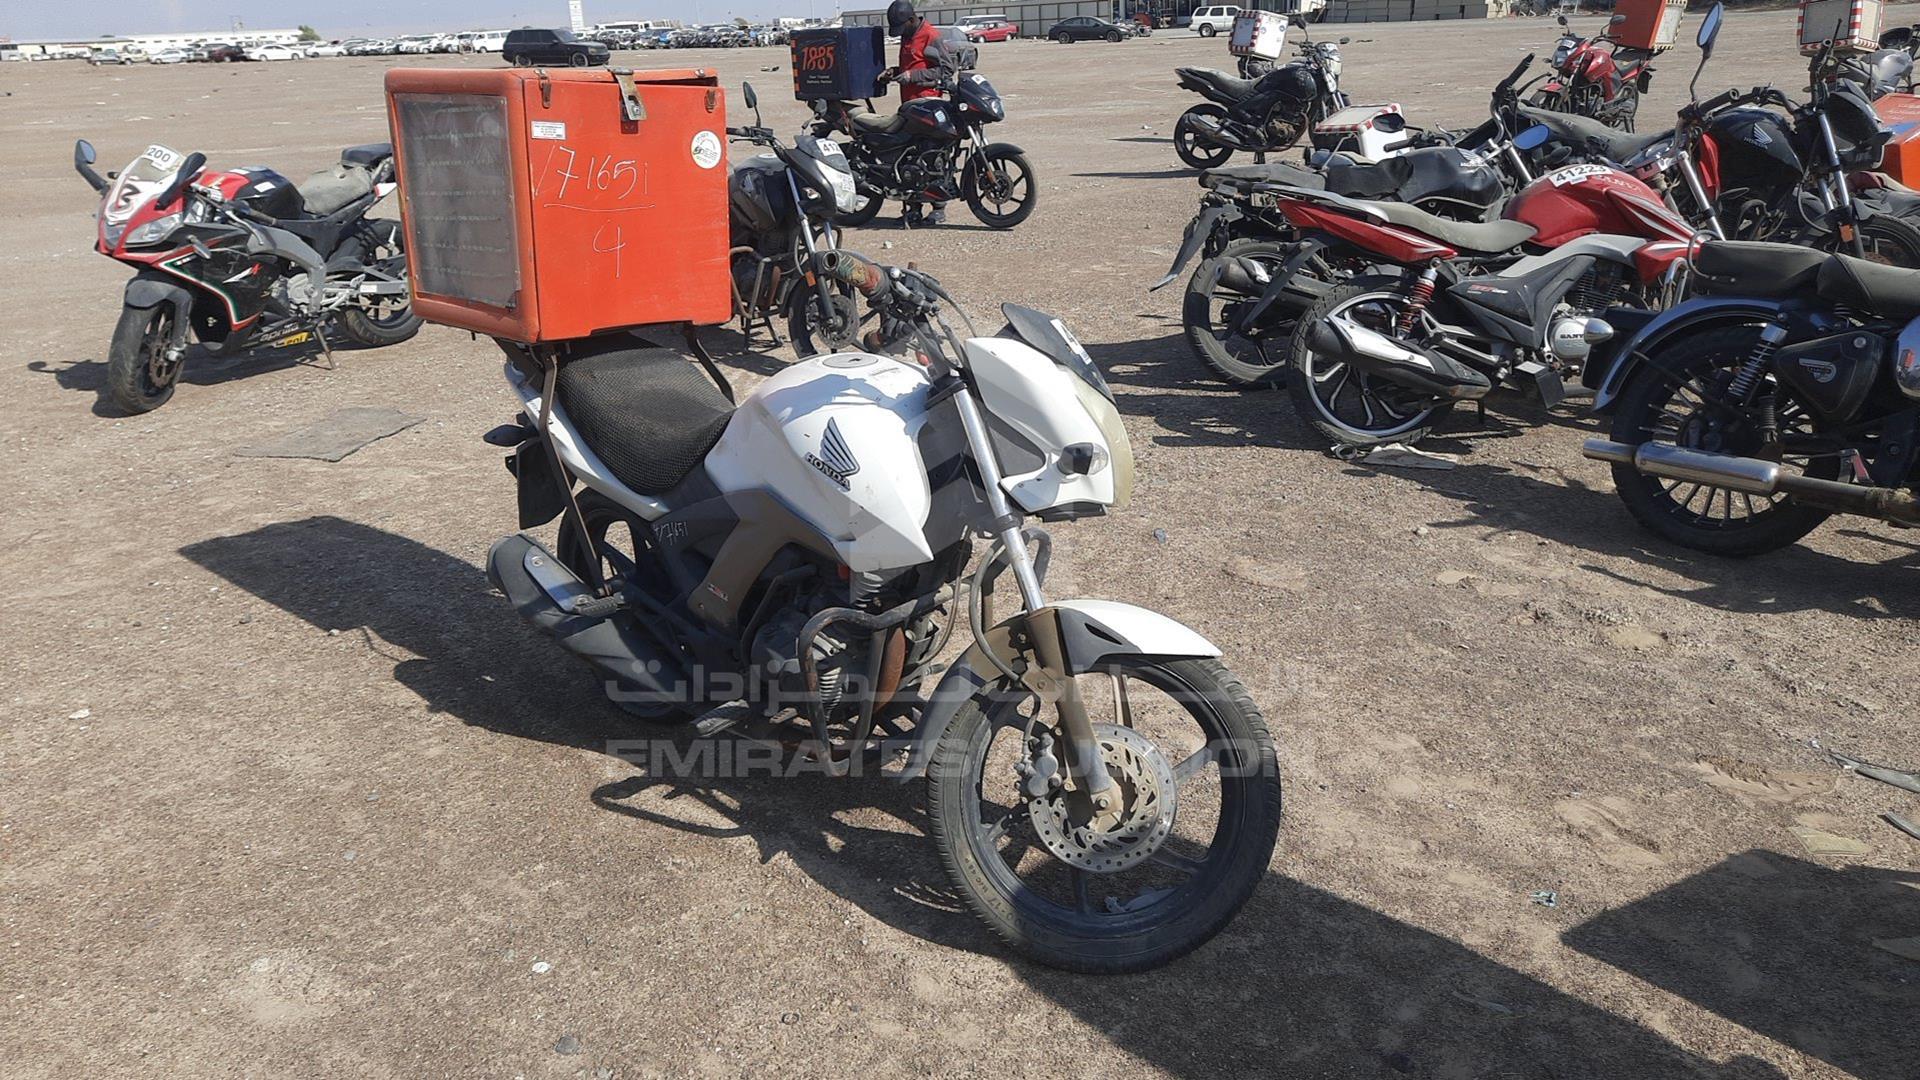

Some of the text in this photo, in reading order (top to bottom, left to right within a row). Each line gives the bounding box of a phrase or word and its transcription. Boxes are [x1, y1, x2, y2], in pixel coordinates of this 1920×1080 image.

[802, 46, 835, 70] 1885
[593, 219, 626, 278] 4
[805, 452, 850, 492] HONDA
